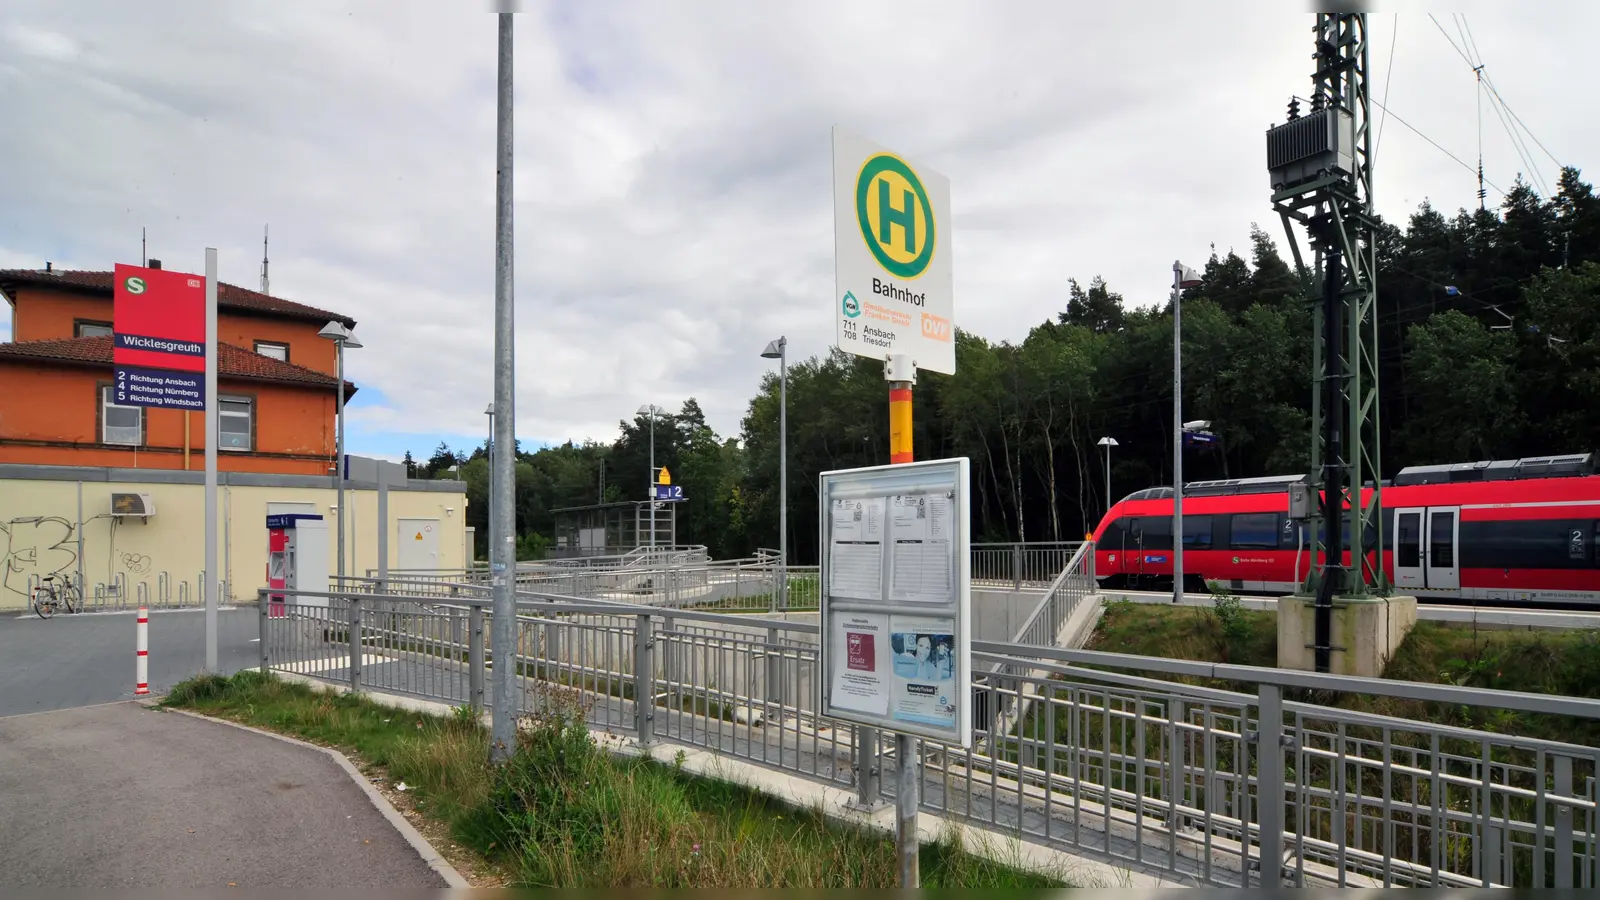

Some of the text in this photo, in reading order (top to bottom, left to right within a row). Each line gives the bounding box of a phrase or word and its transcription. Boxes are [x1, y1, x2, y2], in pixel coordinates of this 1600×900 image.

[879, 178, 916, 254] H
[127, 277, 144, 294] S
[872, 277, 926, 307] Bahnhof
[845, 302, 856, 310] VGN
[843, 320, 896, 340] 711 Ansbach
[123, 335, 201, 353] Wicklesgreuth
[843, 330, 891, 348] 708 Triesdorf
[118, 371, 196, 387] 2 Richtung Ansbach
[118, 381, 199, 398] 4 Richtung Nürnberg
[118, 391, 203, 407] 5 Richtung Windsbach
[675, 486, 682, 497] 2
[1285, 520, 1292, 529] 2
[1572, 530, 1582, 542] 2
